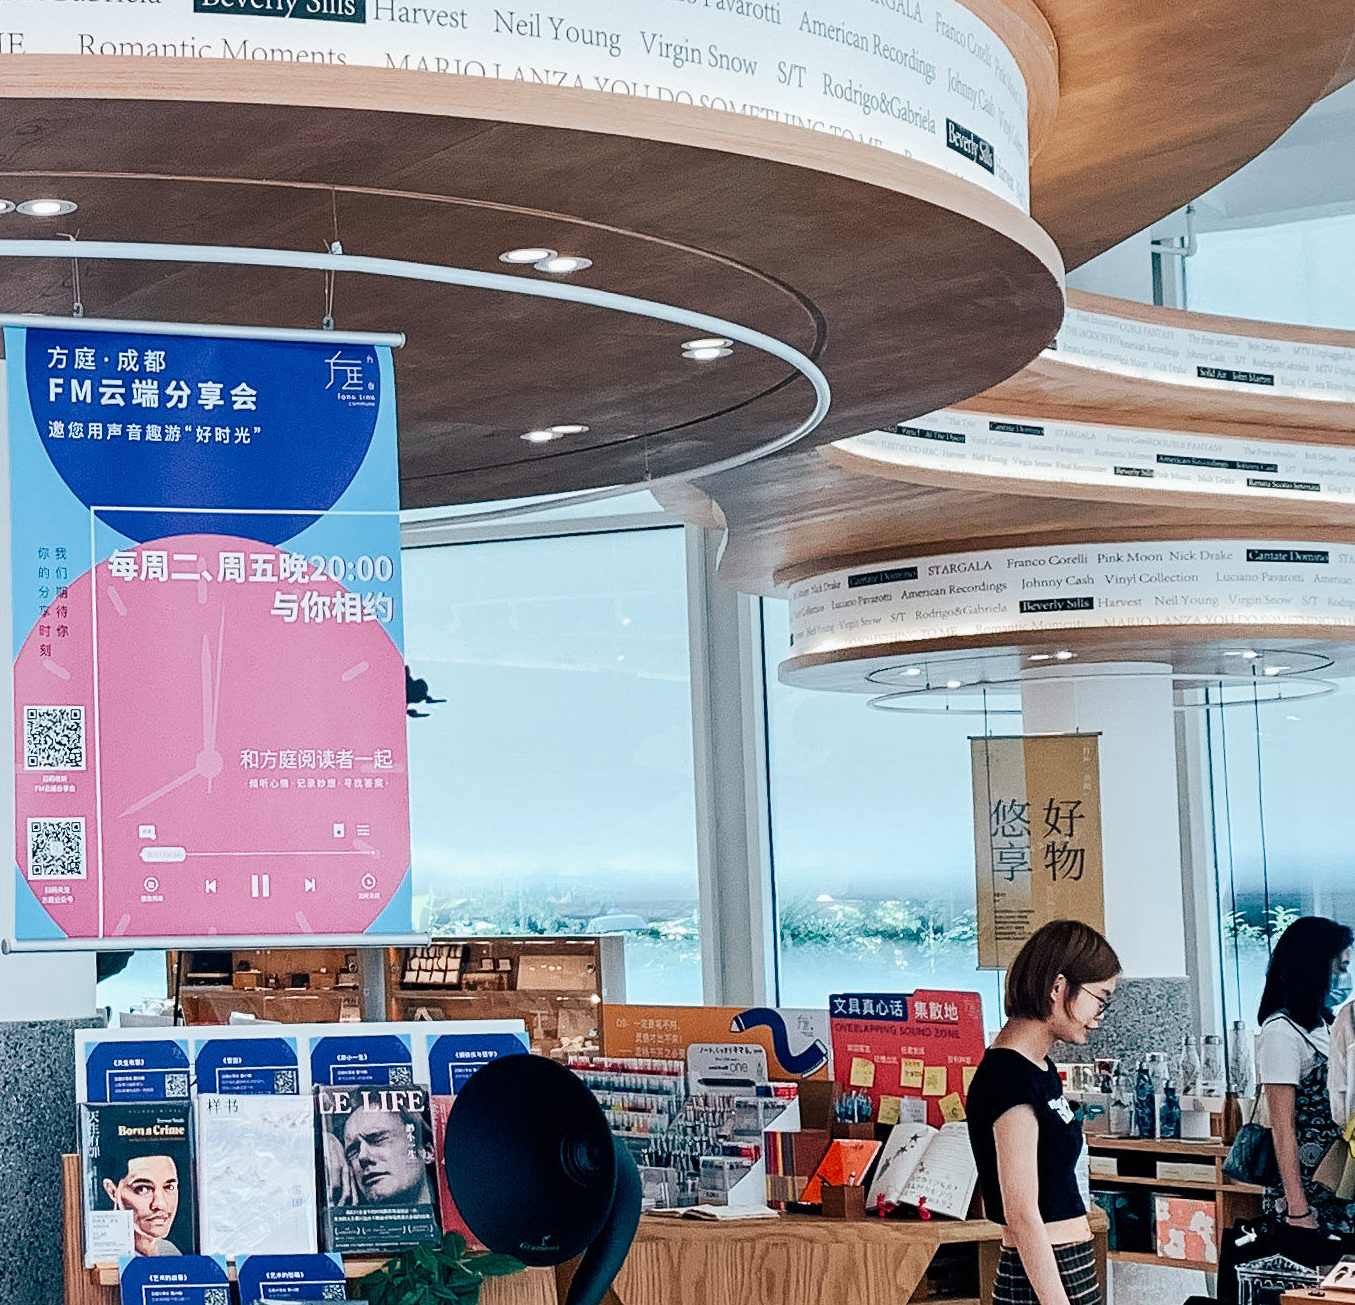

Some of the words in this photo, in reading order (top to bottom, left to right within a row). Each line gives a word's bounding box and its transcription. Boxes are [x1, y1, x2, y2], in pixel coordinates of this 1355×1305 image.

[49, 377, 257, 411] FM云端分享会
[107, 550, 394, 584] 每周二、周五晚20:00
[271, 591, 394, 624] 与你相约
[240, 749, 393, 769] 和方庭阅读者一起
[991, 798, 1032, 882] 悠享
[1043, 797, 1086, 882] 好物
[833, 998, 904, 1018] 文具真心话
[913, 1000, 959, 1022] 集散地
[361, 1091, 425, 1113] LIFE
[118, 1125, 145, 1135] Born
[153, 1125, 185, 1135] Crime
